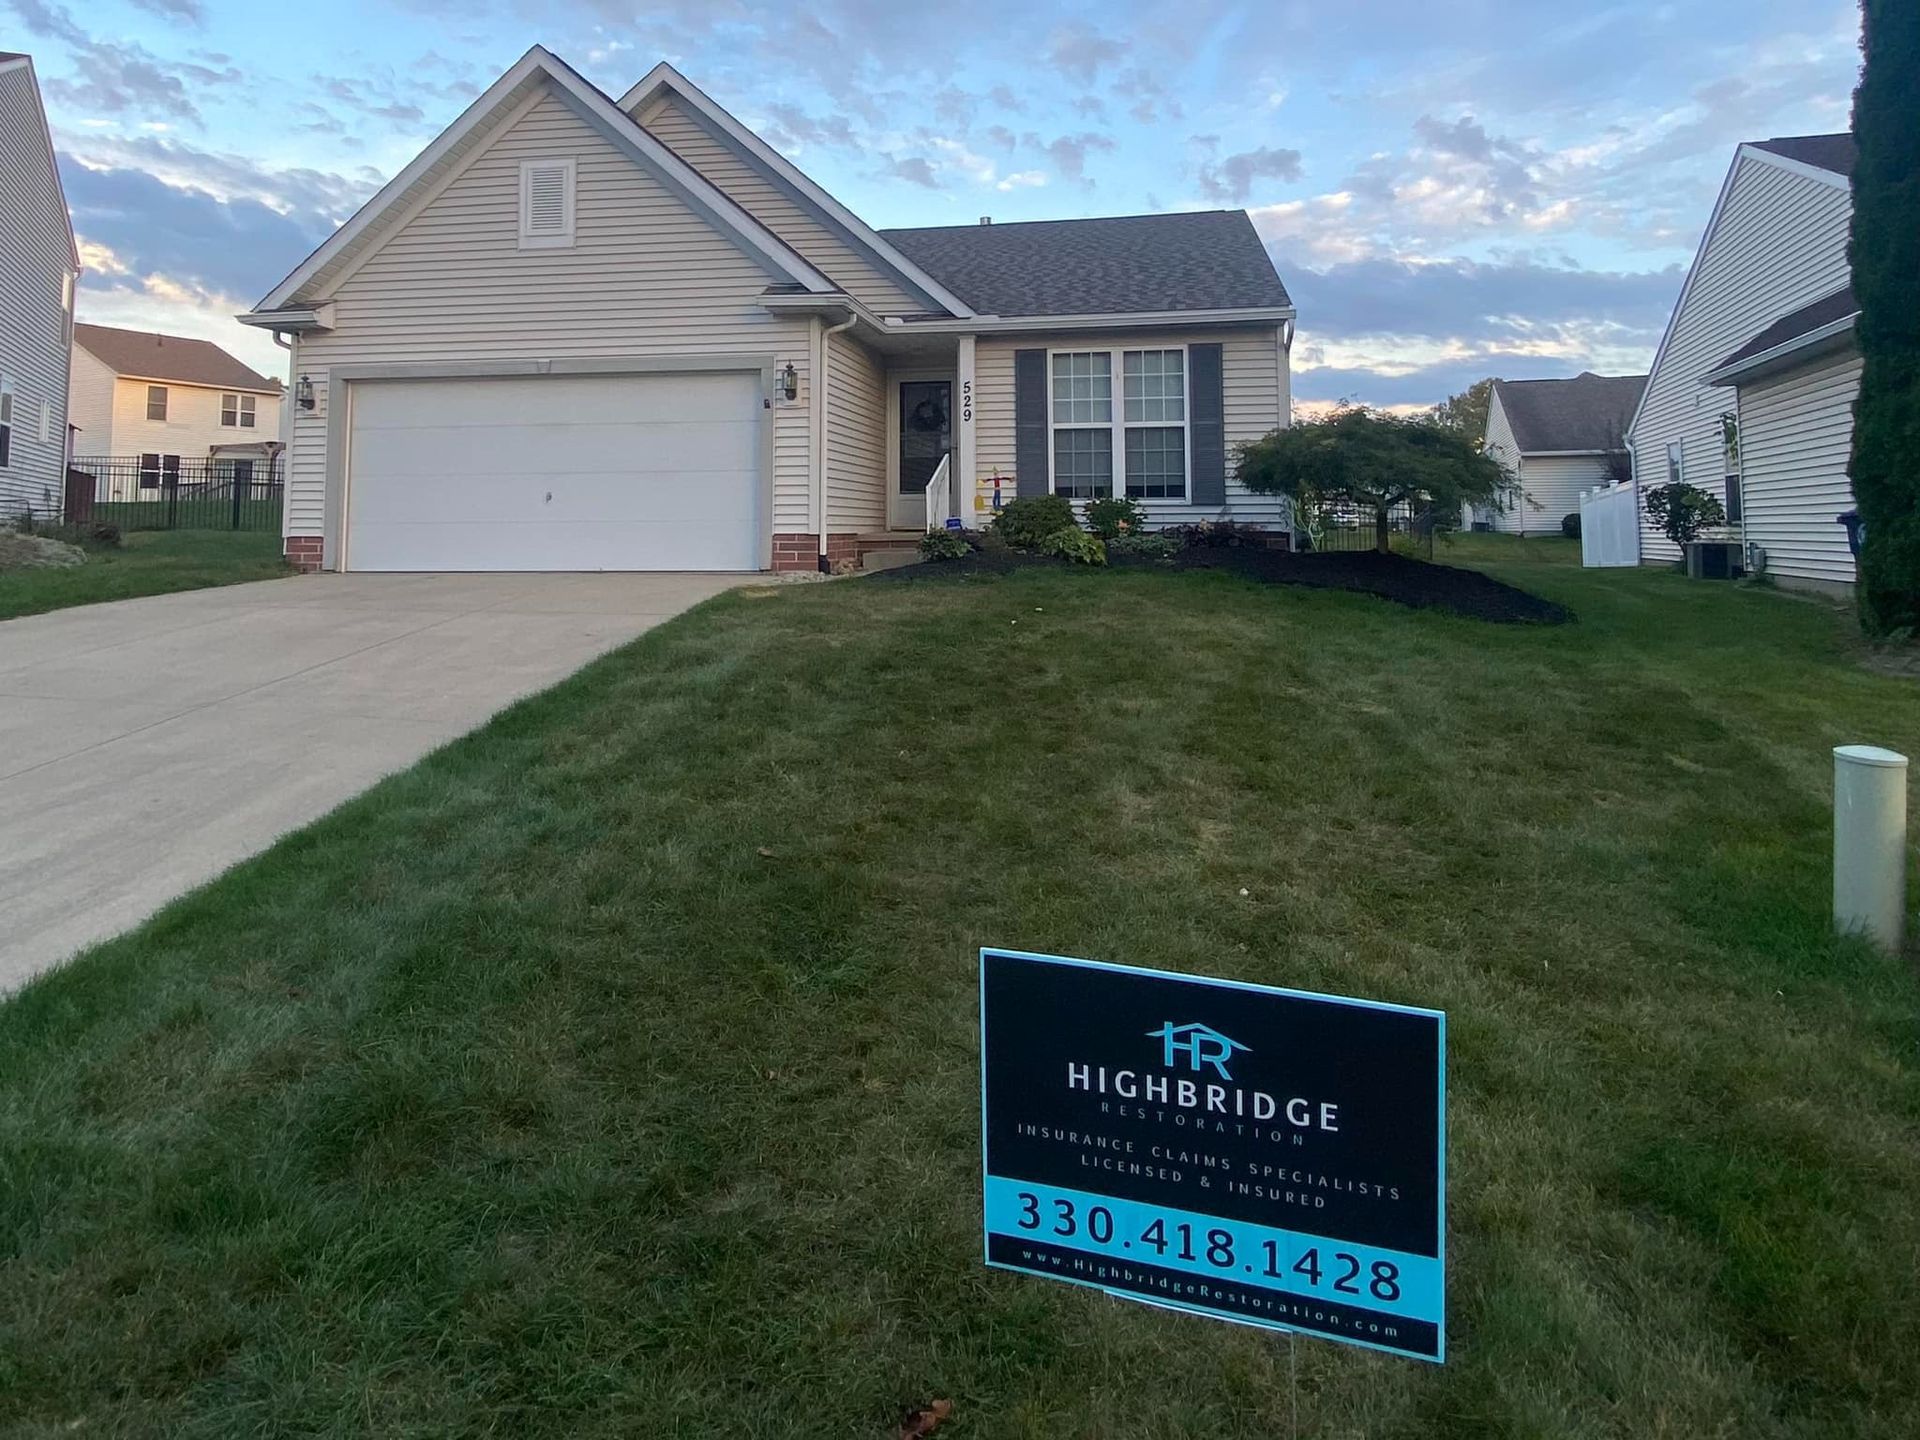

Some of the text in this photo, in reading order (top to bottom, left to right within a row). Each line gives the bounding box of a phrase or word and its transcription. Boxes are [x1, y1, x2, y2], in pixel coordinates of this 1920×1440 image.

[963, 380, 972, 422] 529
[1067, 1061, 1340, 1132] HIGHBRIDGE
[1101, 1102, 1304, 1146] RESTORATION
[1017, 1123, 1400, 1200] INSURANCE CLAIMS SPECIALISTS
[1081, 1154, 1326, 1209] LICENSED & INSURED
[1017, 1192, 1401, 1302] 330.418.1428
[1022, 1249, 1398, 1337] www.HighbridgeRestoration.com
